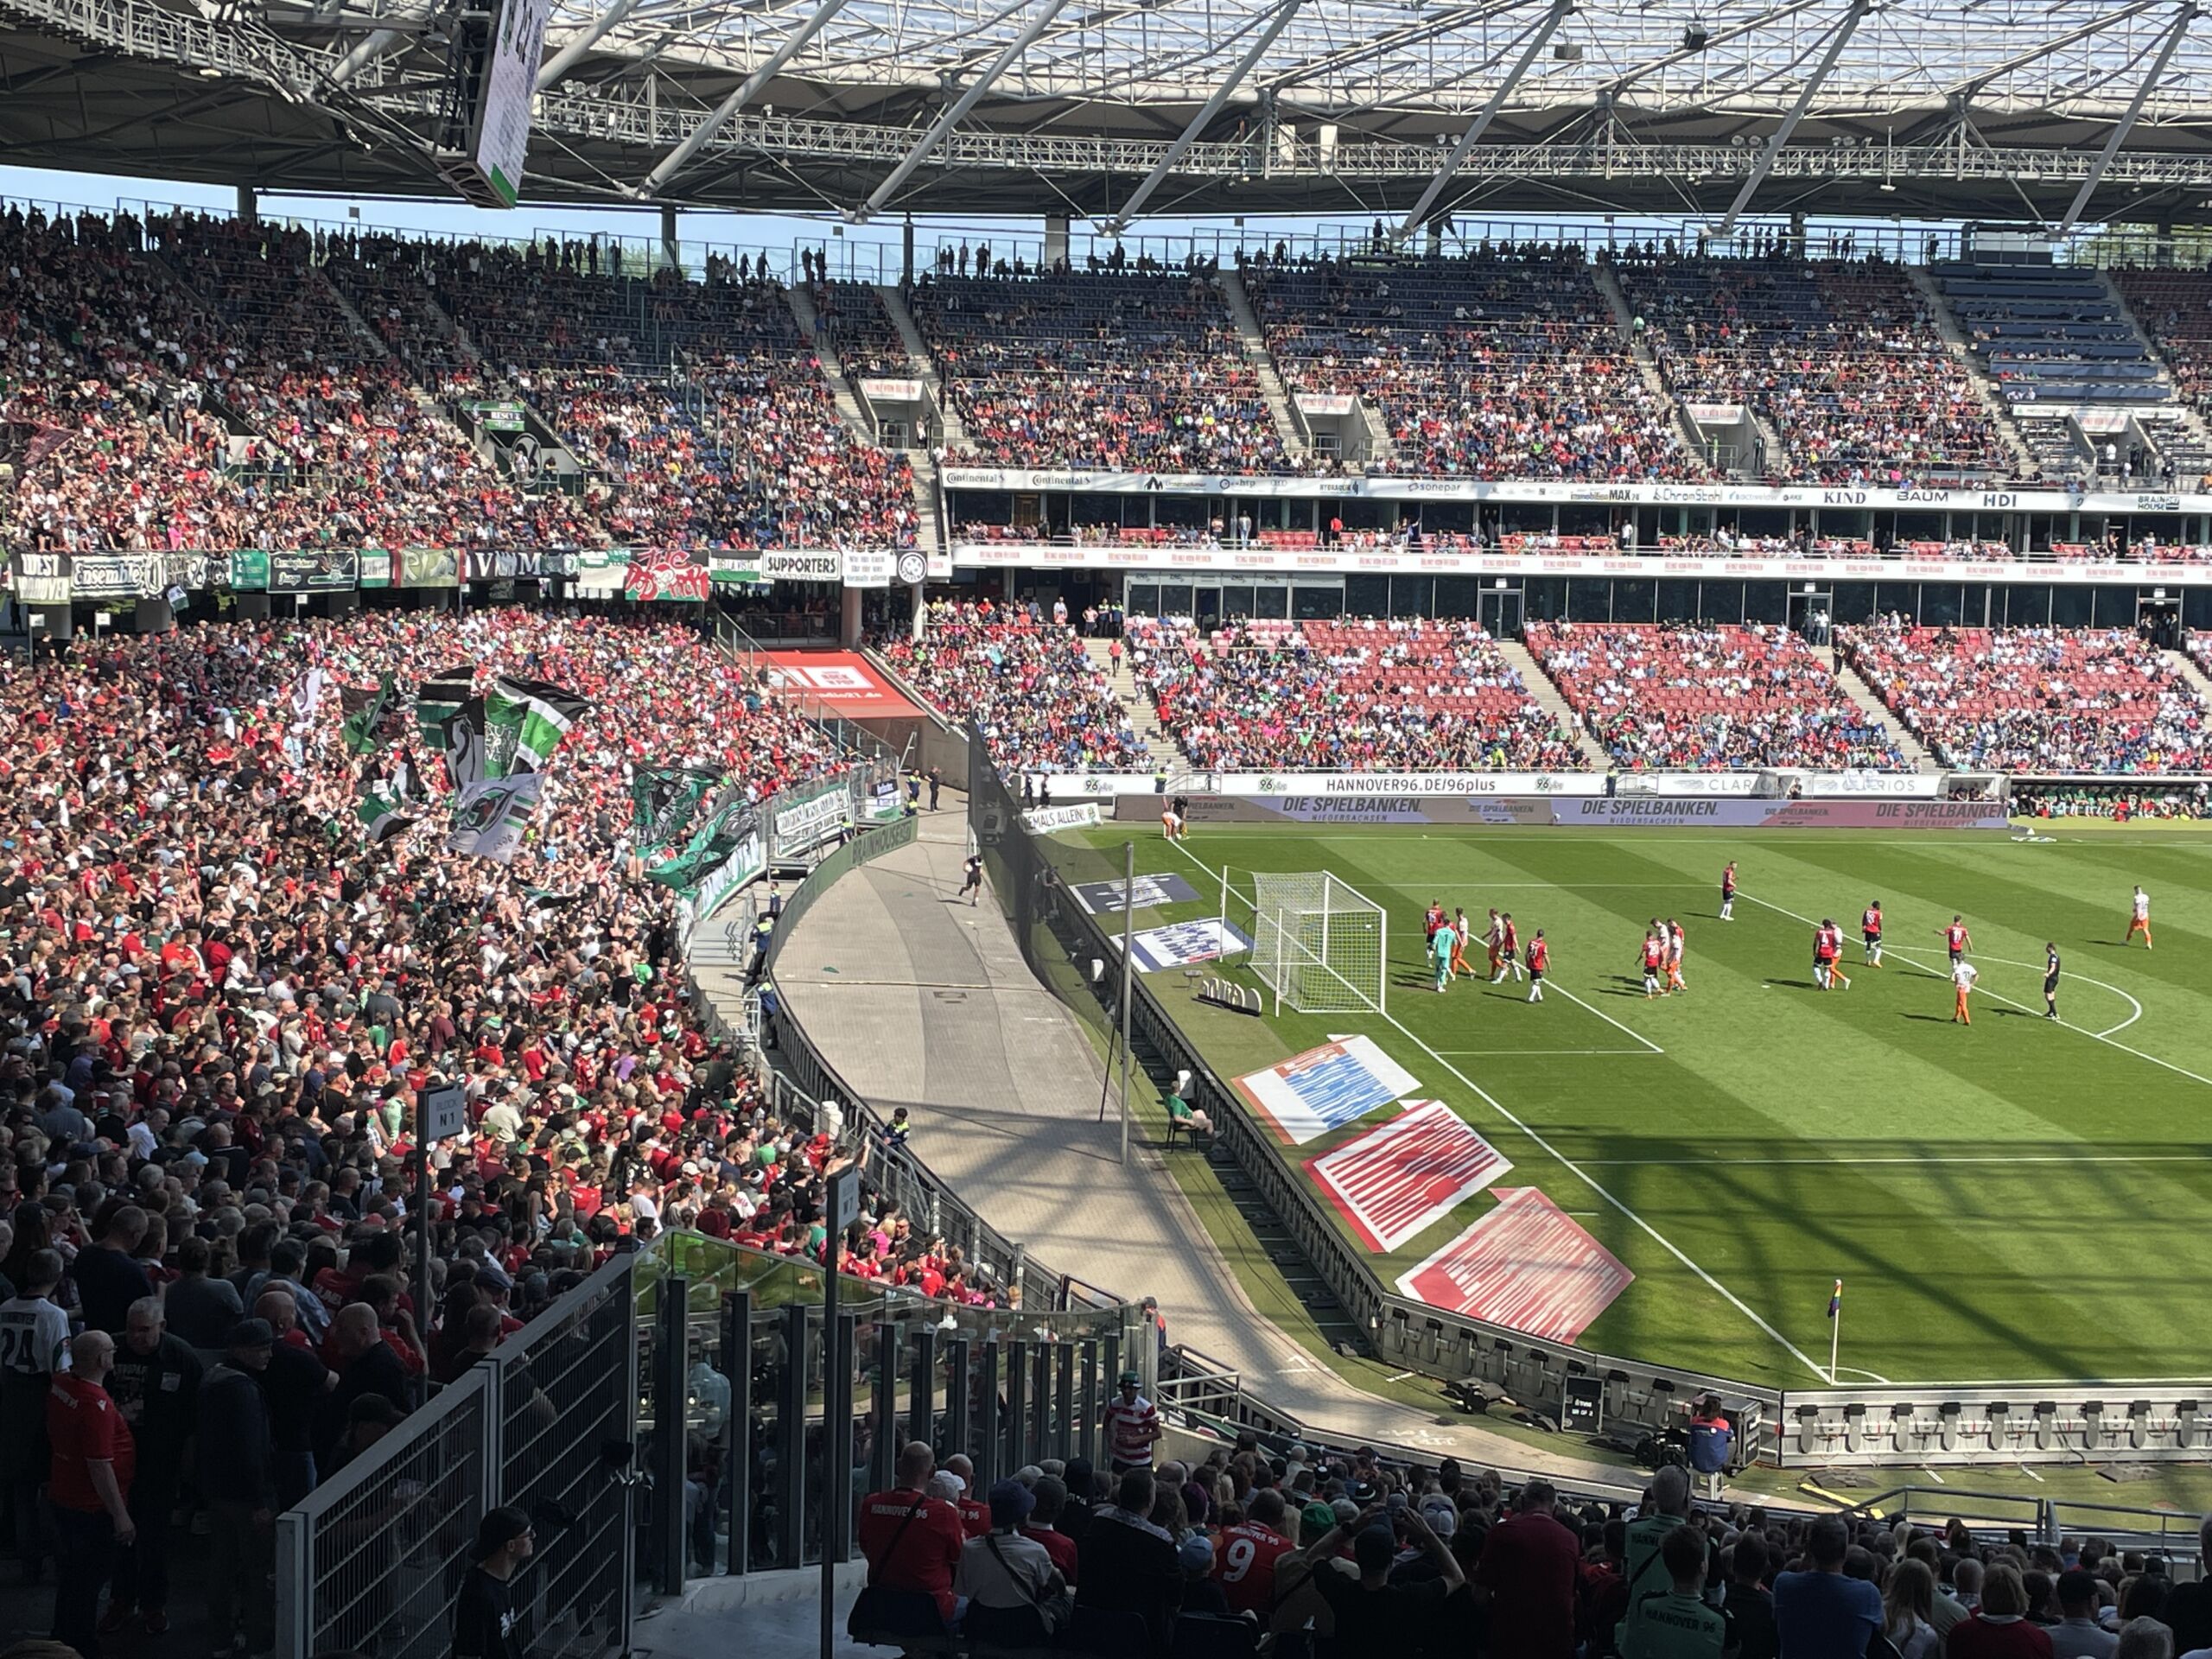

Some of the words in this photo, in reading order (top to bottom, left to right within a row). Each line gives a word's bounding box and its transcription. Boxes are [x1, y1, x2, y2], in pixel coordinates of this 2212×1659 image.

[947, 473, 997, 484] Continental
[1033, 474, 1084, 486] Continental
[1420, 483, 1460, 492] sonepar
[1824, 492, 1866, 504] KIND
[1897, 492, 1948, 502] BAUM
[1984, 494, 2017, 507] HDI
[21, 554, 60, 576] WEST
[767, 556, 836, 574] SUPPORTERS
[73, 563, 141, 586] Ensemble
[1326, 779, 1496, 794] HANNOVER96.DE/96plus
[1283, 798, 1309, 812] DIE
[1313, 798, 1422, 813] SPIELBANKEN.
[1581, 800, 1606, 814] DIE
[1611, 800, 1719, 816] SPIELBANKEN.
[1876, 804, 1901, 817] DIE
[2, 1327, 39, 1373] 24
[915, 1509, 928, 1519] 96
[968, 1510, 980, 1520] 96
[1223, 1538, 1256, 1583] 9
[1644, 1608, 1700, 1631] HANNOVER
